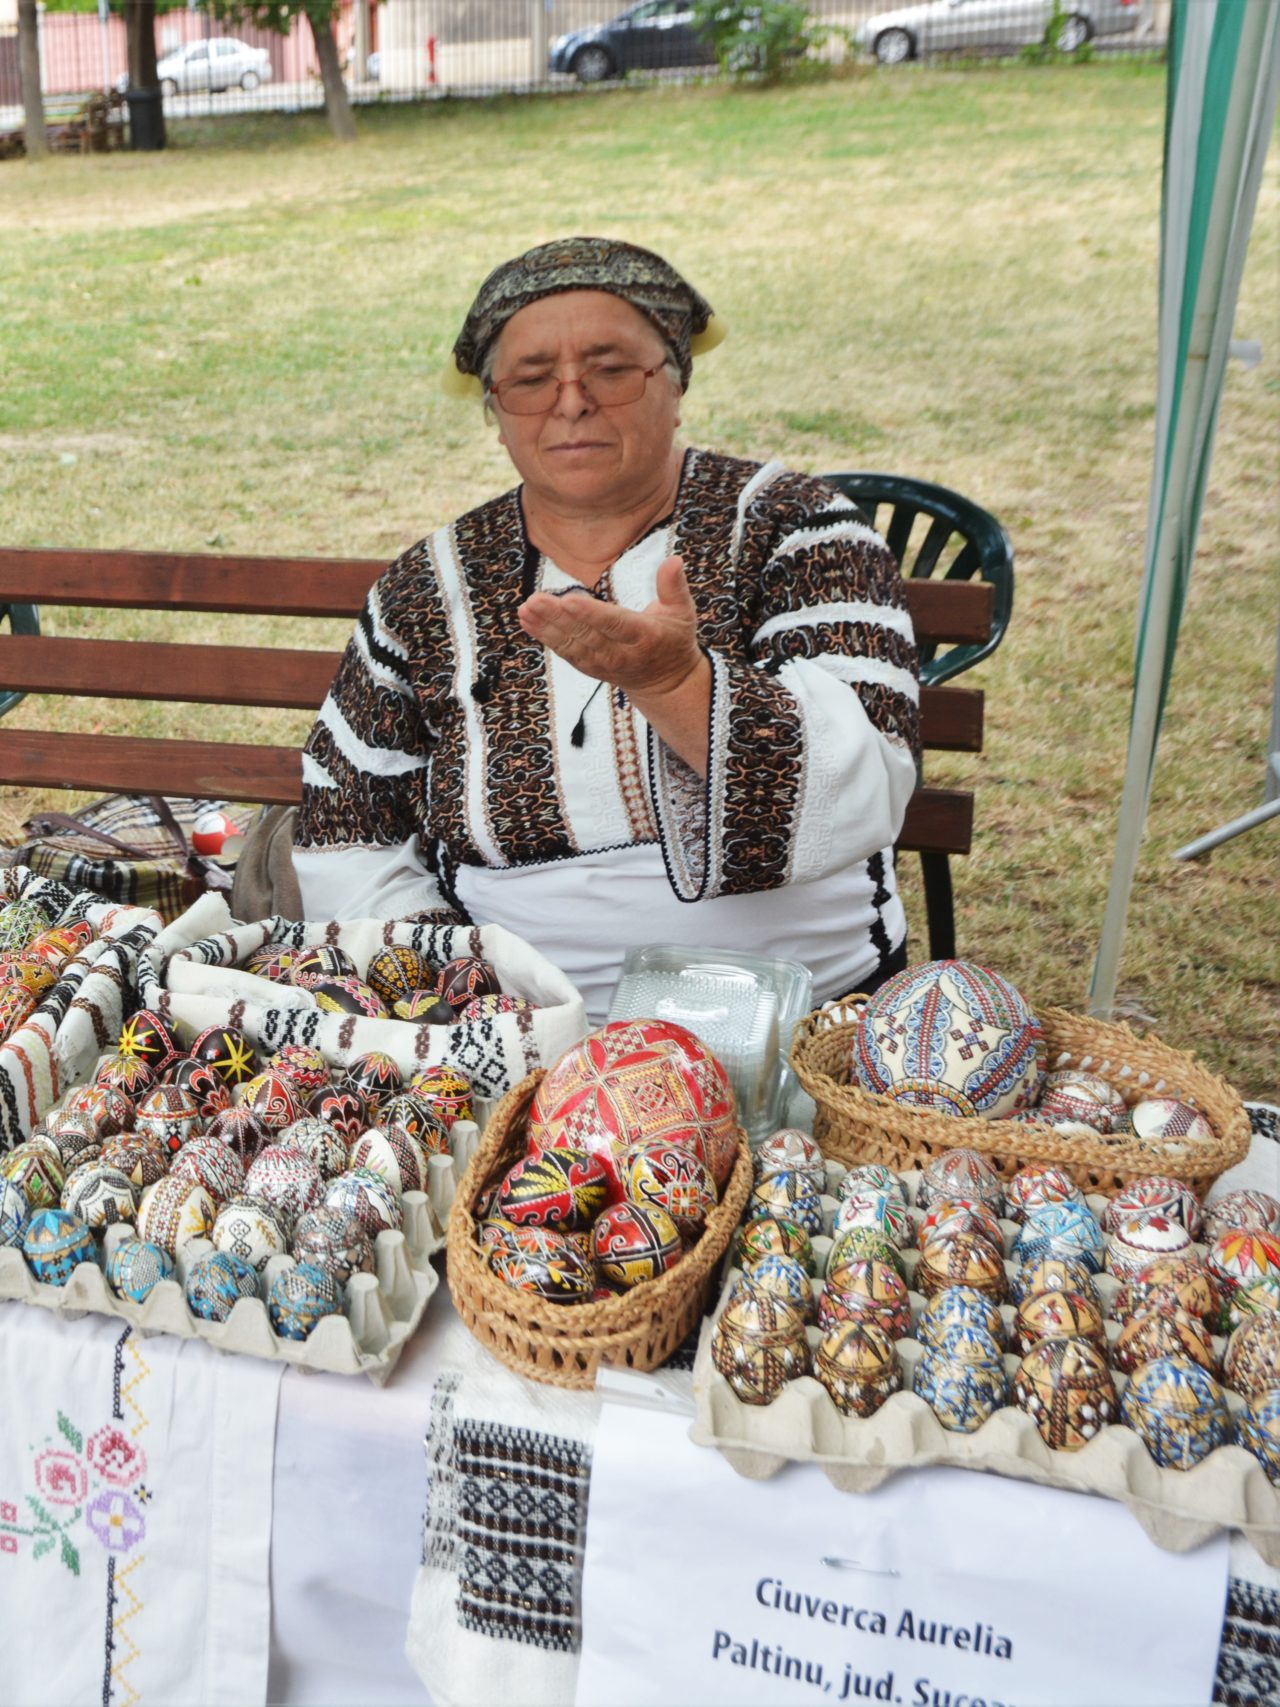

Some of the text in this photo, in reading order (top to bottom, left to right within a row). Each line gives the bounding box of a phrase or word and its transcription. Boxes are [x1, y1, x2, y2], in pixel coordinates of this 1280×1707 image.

[755, 1577, 1014, 1660] Ciuverca Aurelia
[711, 1629, 1017, 1707] Paltinu, jud. Suc
